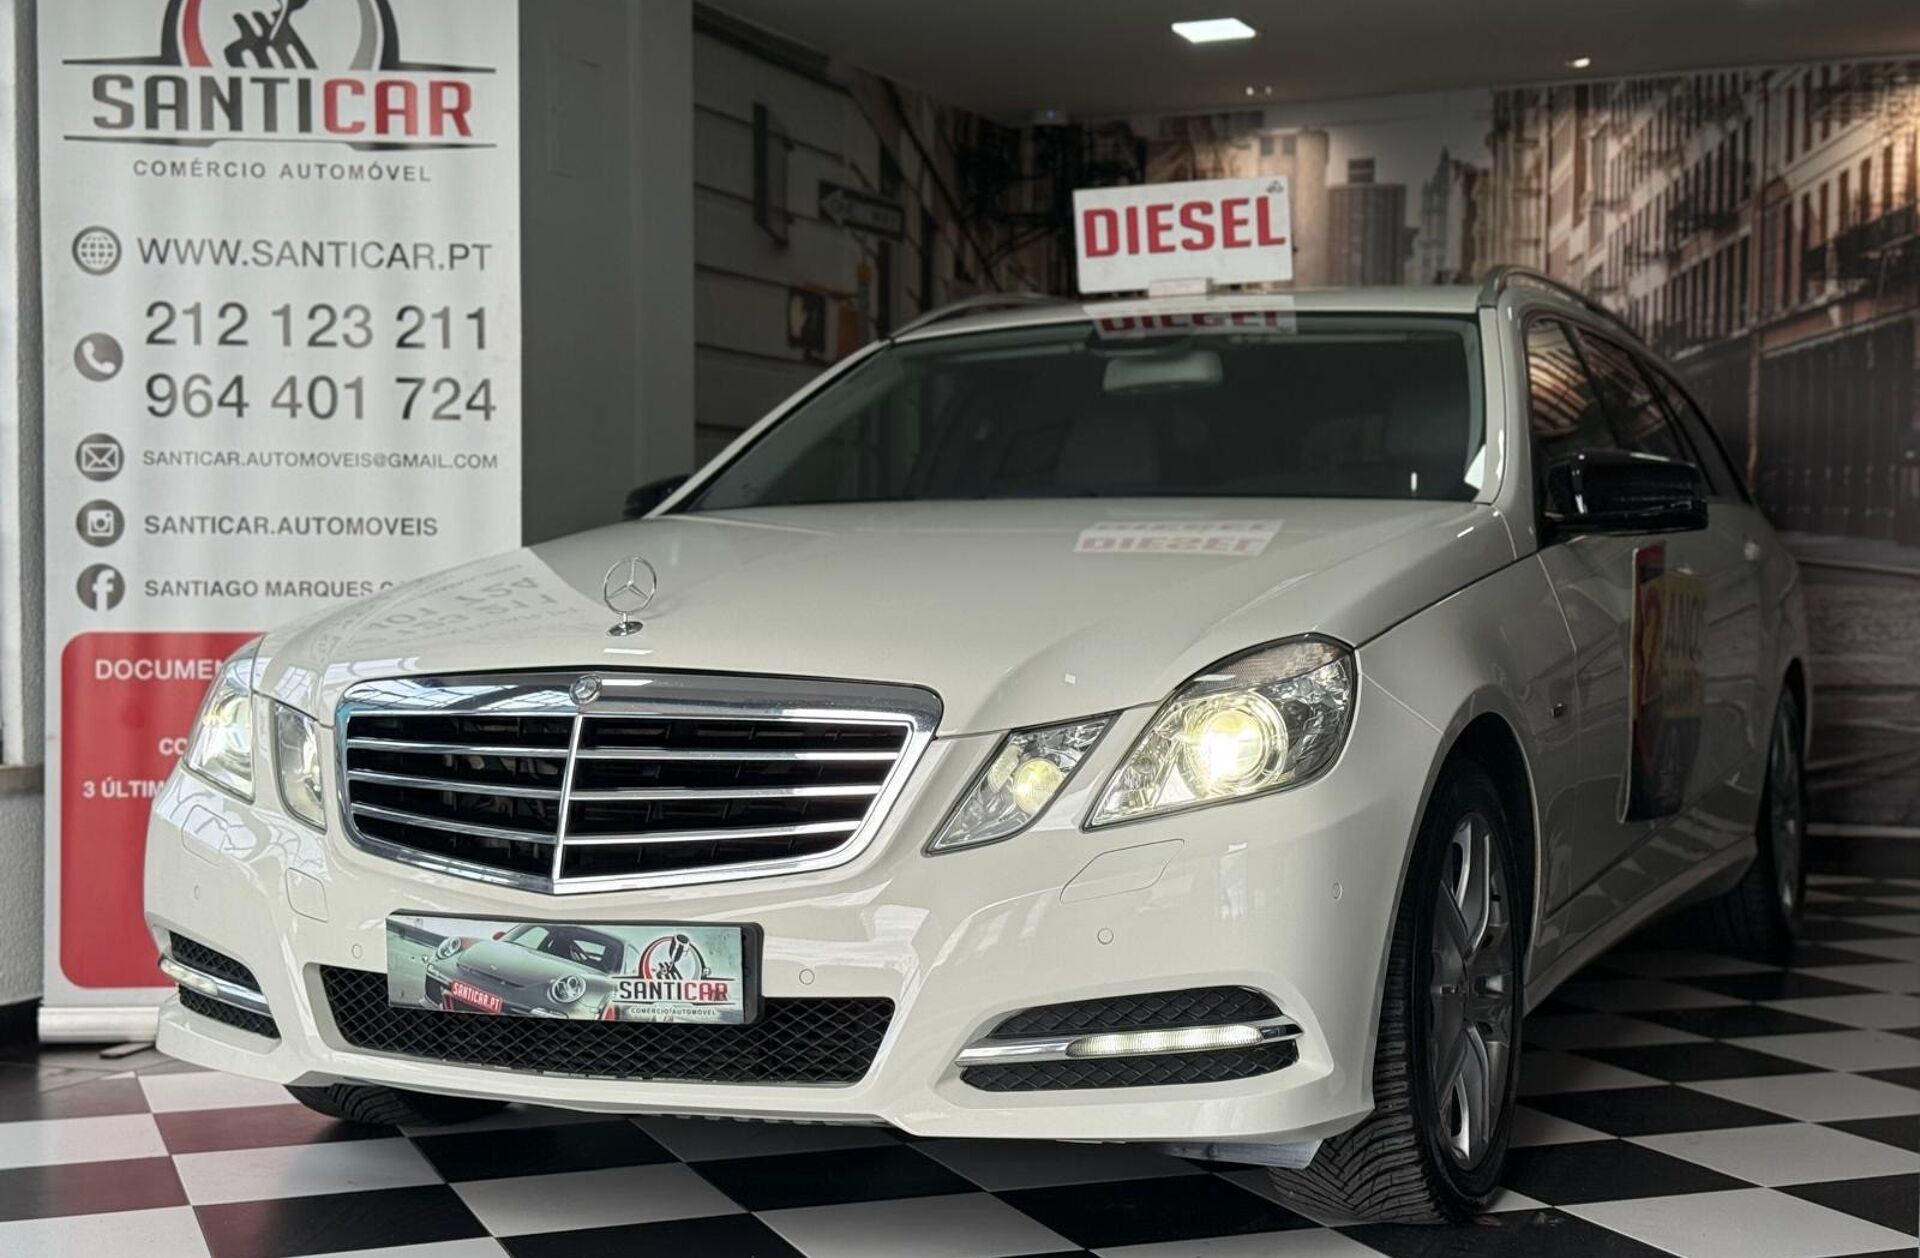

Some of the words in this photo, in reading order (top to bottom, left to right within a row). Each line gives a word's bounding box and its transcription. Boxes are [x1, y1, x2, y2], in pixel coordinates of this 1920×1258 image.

[92, 74, 472, 137] SANTICAR
[133, 158, 266, 178] COMÉRCIO
[280, 161, 431, 182] AUTOMÓVEL
[1083, 196, 1286, 258] DIESEL
[137, 238, 492, 270] WWW.SANTICAR.PT
[146, 301, 249, 346] 212
[272, 303, 373, 348] 123
[395, 305, 486, 350] 211
[146, 373, 249, 418] 964
[271, 375, 364, 420] 401
[395, 377, 496, 421] 724
[143, 450, 498, 469] SANTICAR.AUTOMOVEIS@GMAIL.COM
[144, 515, 438, 536] SANTICAR.AUTOMOVEIS
[144, 580, 258, 597] SANTIAGO
[265, 581, 373, 597] MARQUES
[82, 781, 95, 798] 3
[453, 982, 500, 1011] SANTICAR.PT
[619, 981, 728, 1001] SANTICAR
